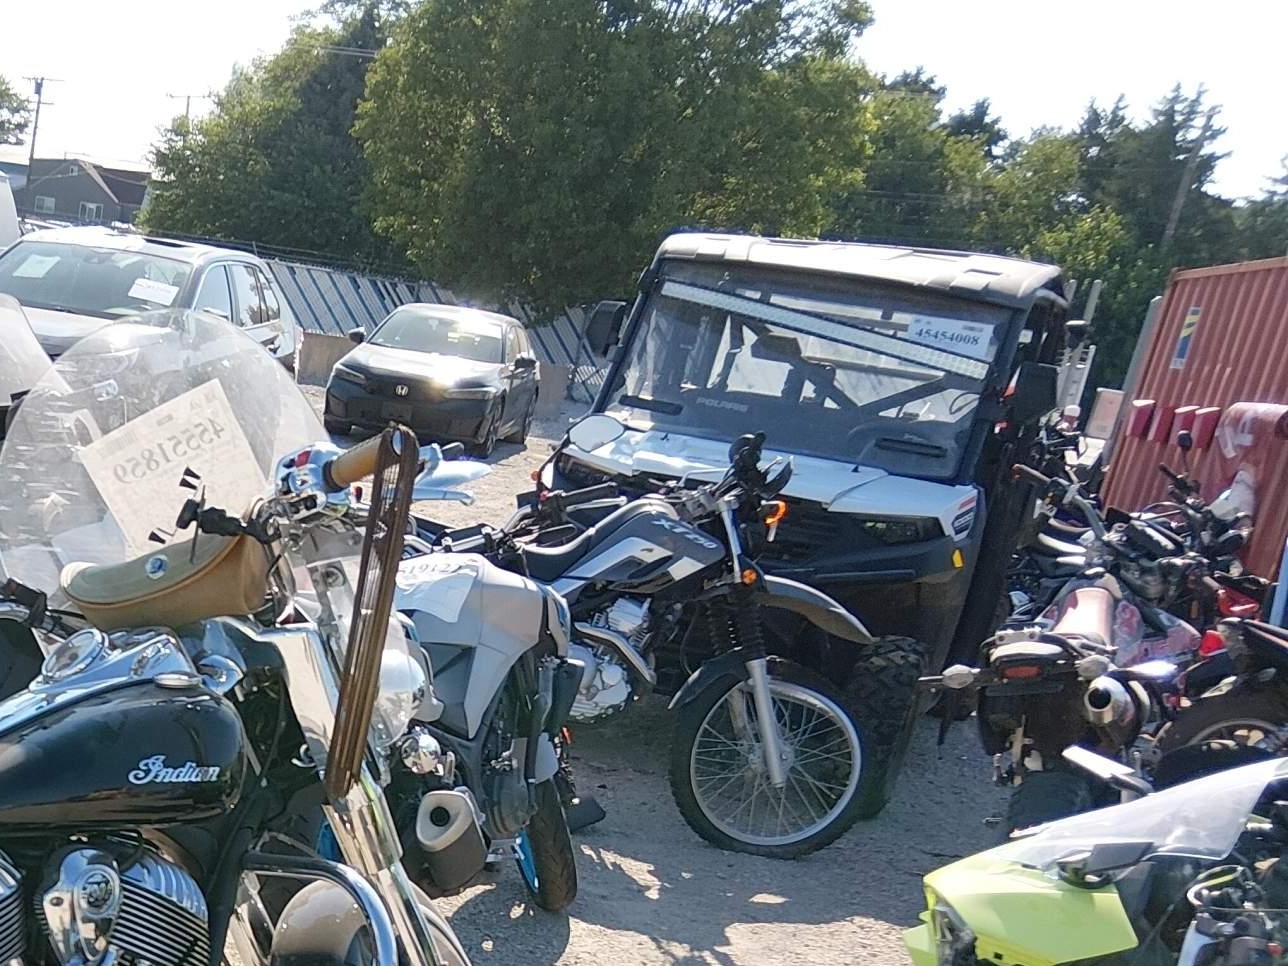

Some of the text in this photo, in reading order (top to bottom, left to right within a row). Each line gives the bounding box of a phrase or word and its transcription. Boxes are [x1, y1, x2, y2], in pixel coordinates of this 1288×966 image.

[914, 327, 980, 346] 45454008
[696, 397, 749, 413] POLARIS
[651, 519, 718, 549] XT250
[128, 755, 221, 785] Indian
